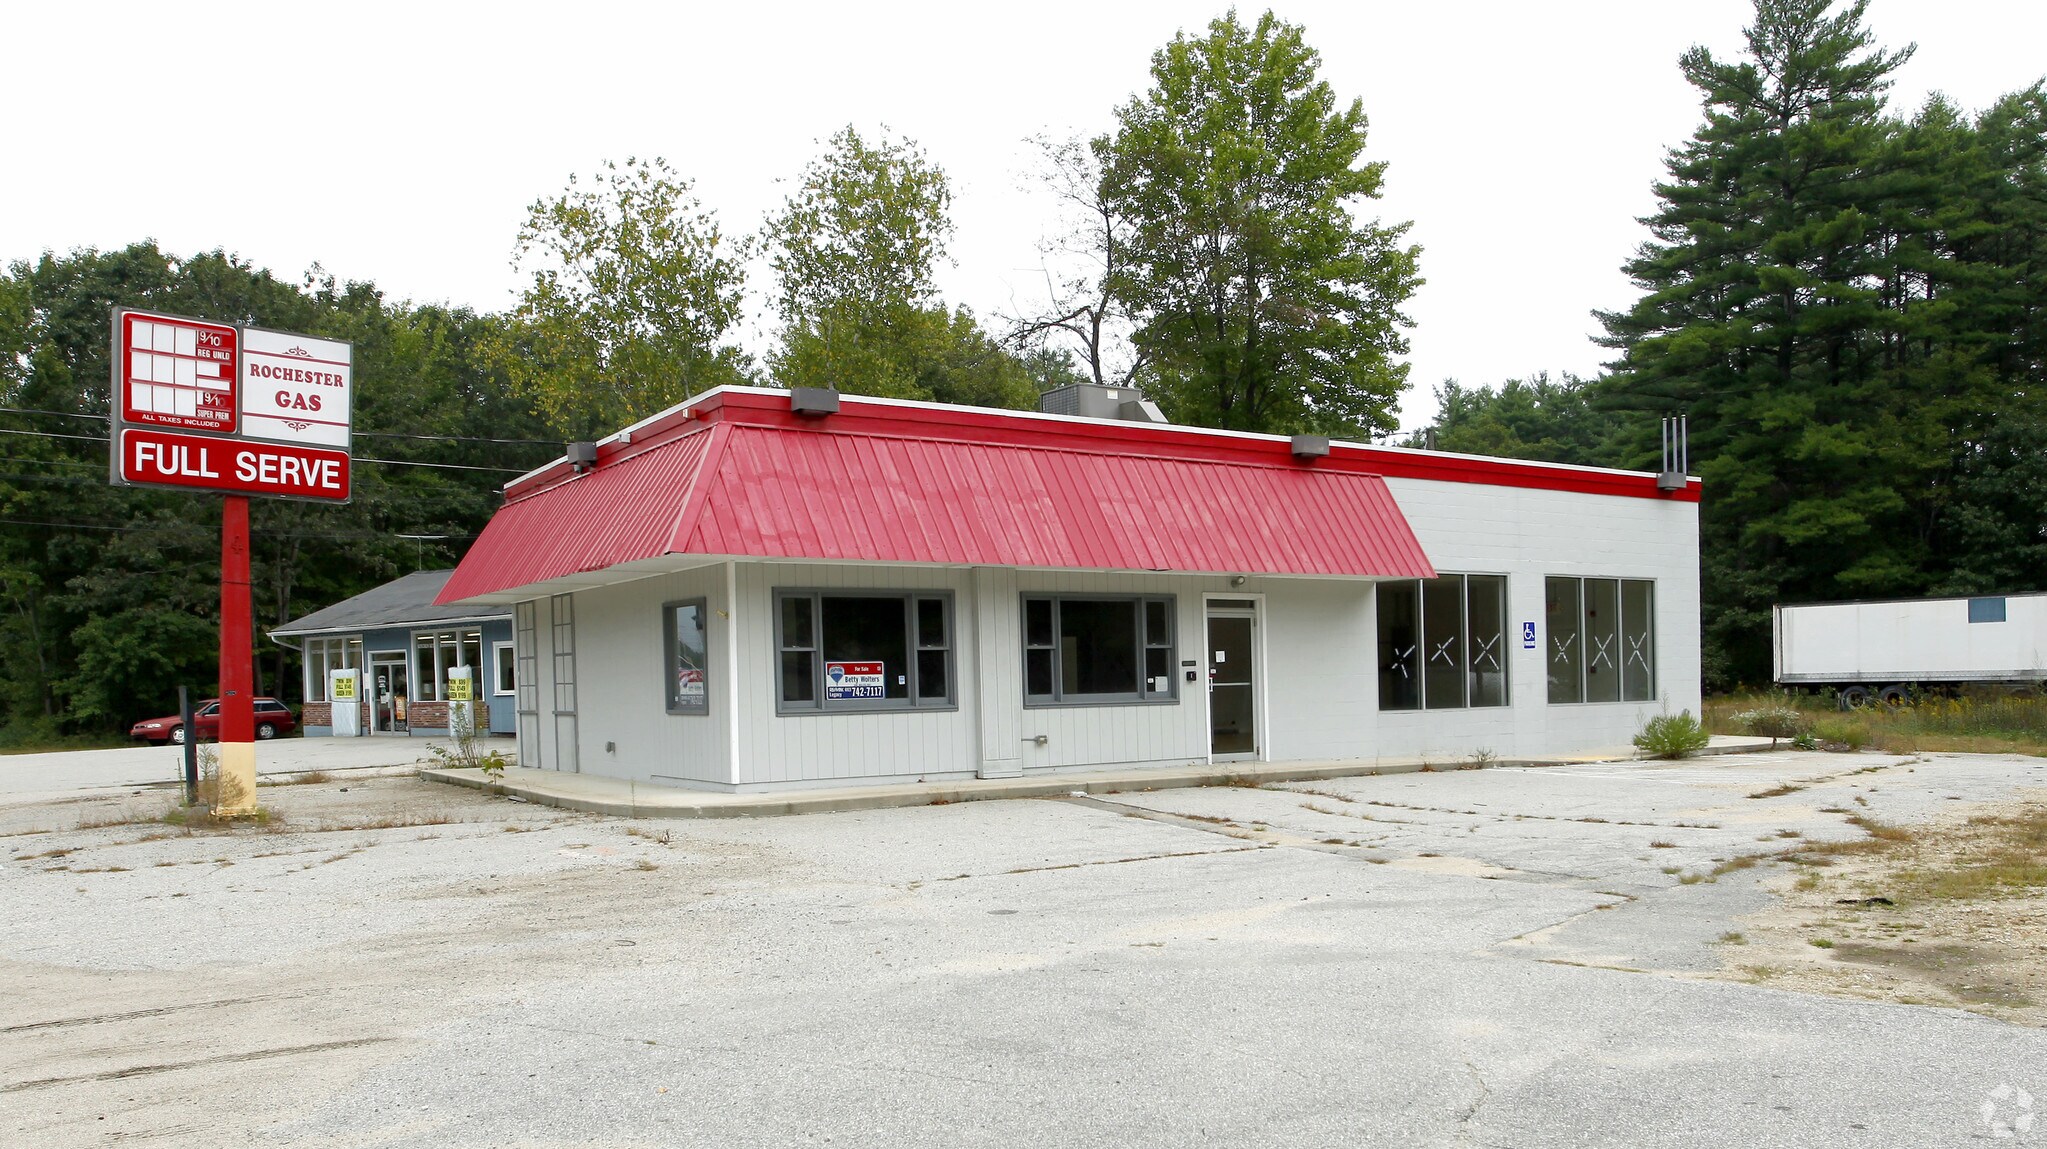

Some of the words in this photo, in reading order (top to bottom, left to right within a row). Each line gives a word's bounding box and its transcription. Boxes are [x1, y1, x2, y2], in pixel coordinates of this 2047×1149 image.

[197, 349, 211, 358] REG
[212, 350, 230, 360] UNLD
[250, 363, 344, 388] ROCHESTER
[275, 390, 322, 412] GAS
[142, 413, 156, 421] ALL
[158, 415, 182, 424] TAXES
[184, 419, 220, 428] INCLUDED
[197, 409, 213, 419] SUPER
[215, 411, 230, 421] PREM
[135, 441, 219, 478] FULL
[235, 450, 341, 489] SERVE
[845, 676, 859, 684] Betty
[852, 687, 882, 697] 742-7117
